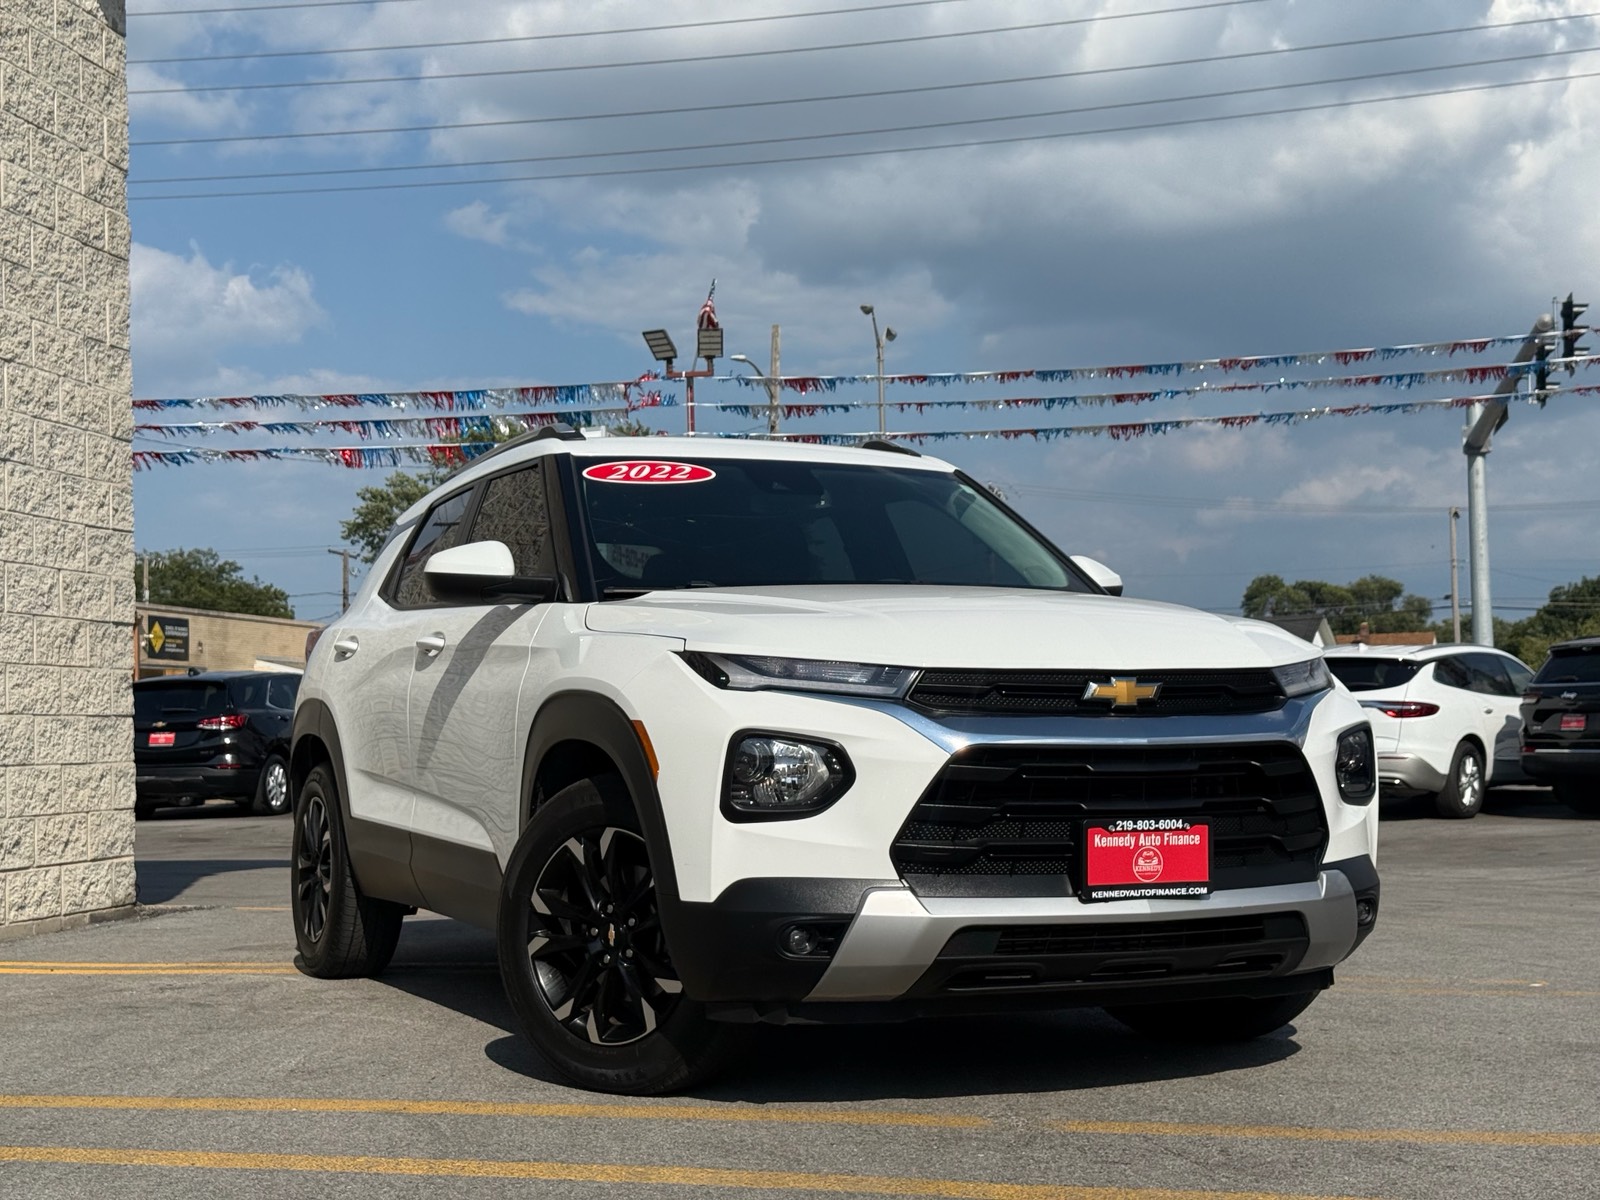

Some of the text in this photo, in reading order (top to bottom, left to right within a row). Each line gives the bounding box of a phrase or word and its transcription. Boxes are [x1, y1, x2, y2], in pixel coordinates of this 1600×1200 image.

[605, 465, 692, 479] 2022
[1116, 819, 1183, 831] 219-803-6004
[1094, 832, 1201, 849] Kennedy Auto Finance
[1135, 864, 1161, 872] KENNEDY
[1092, 887, 1208, 899] KENNEDYAUTOFINANCE.COM
